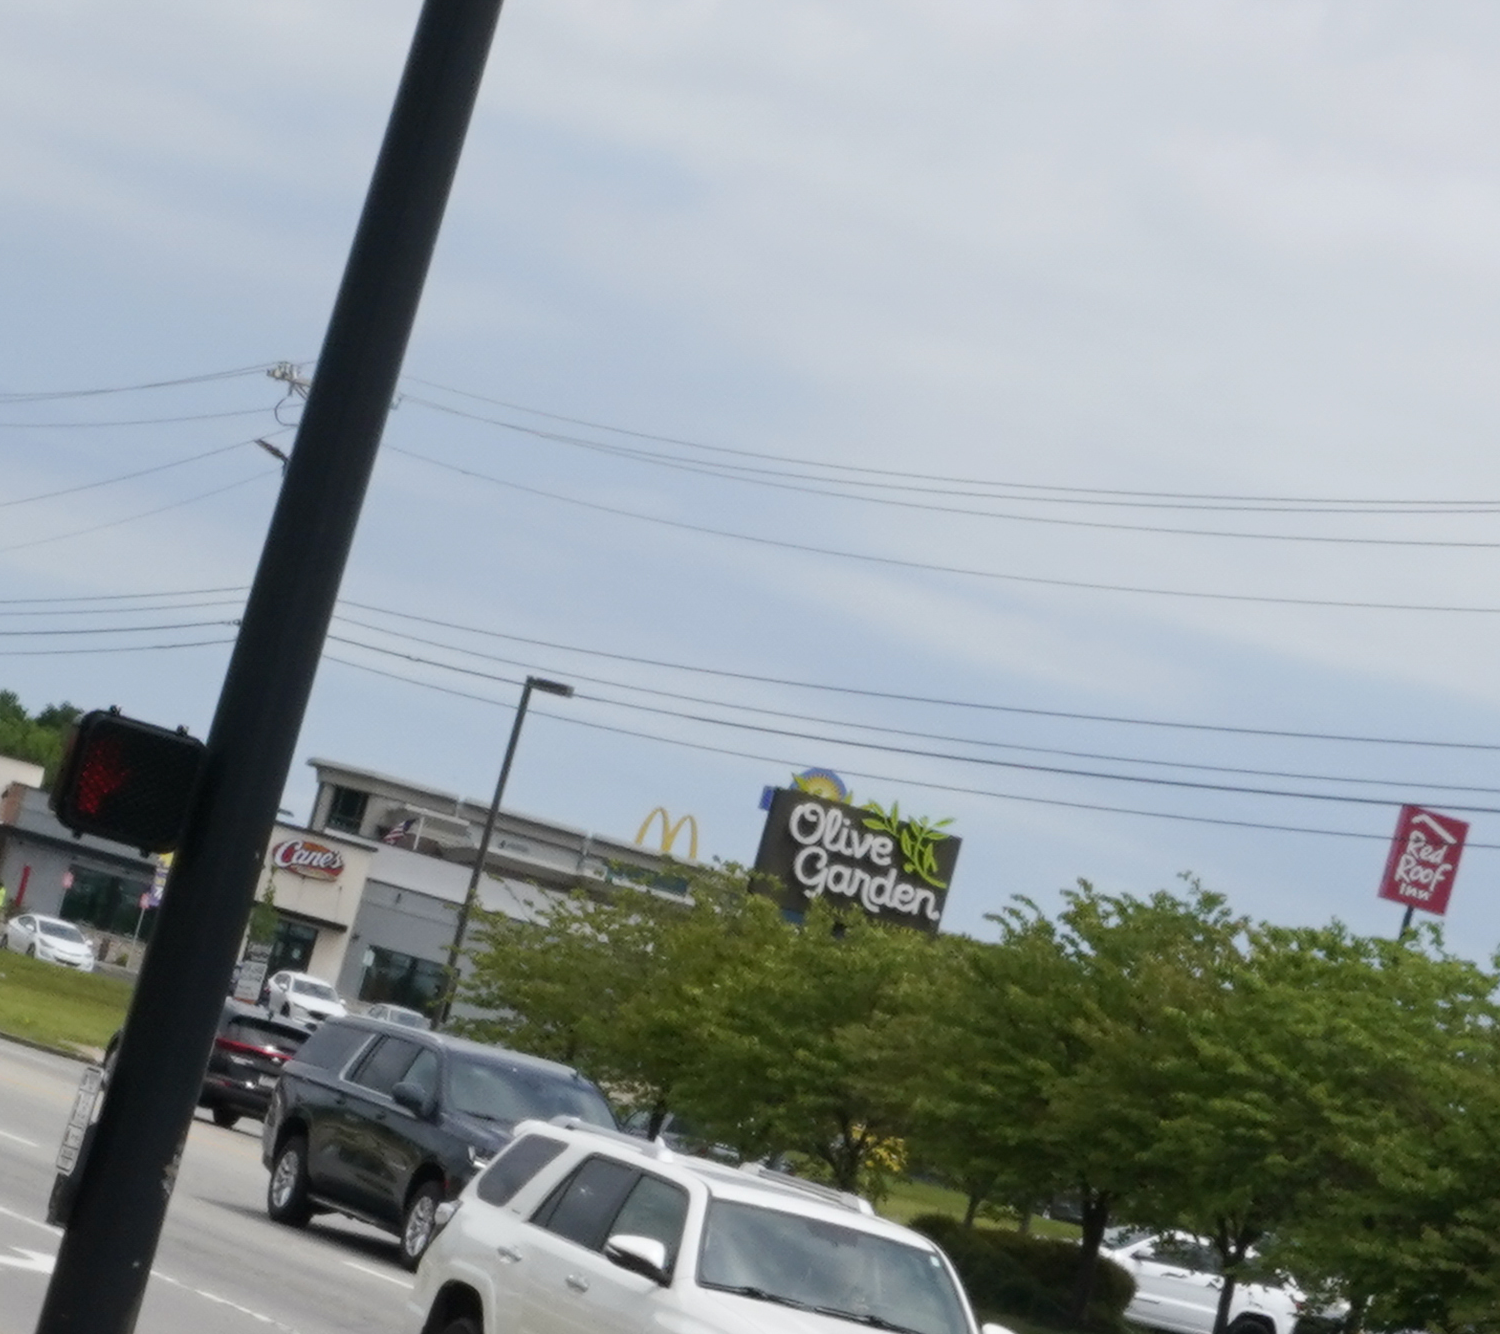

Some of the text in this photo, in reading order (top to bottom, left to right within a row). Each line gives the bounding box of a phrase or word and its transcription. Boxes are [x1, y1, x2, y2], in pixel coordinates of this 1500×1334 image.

[788, 802, 894, 866] Olive
[1406, 830, 1449, 865] Red
[274, 839, 344, 869] Cane's
[1394, 853, 1453, 892] Roof
[793, 846, 941, 921] Garden
